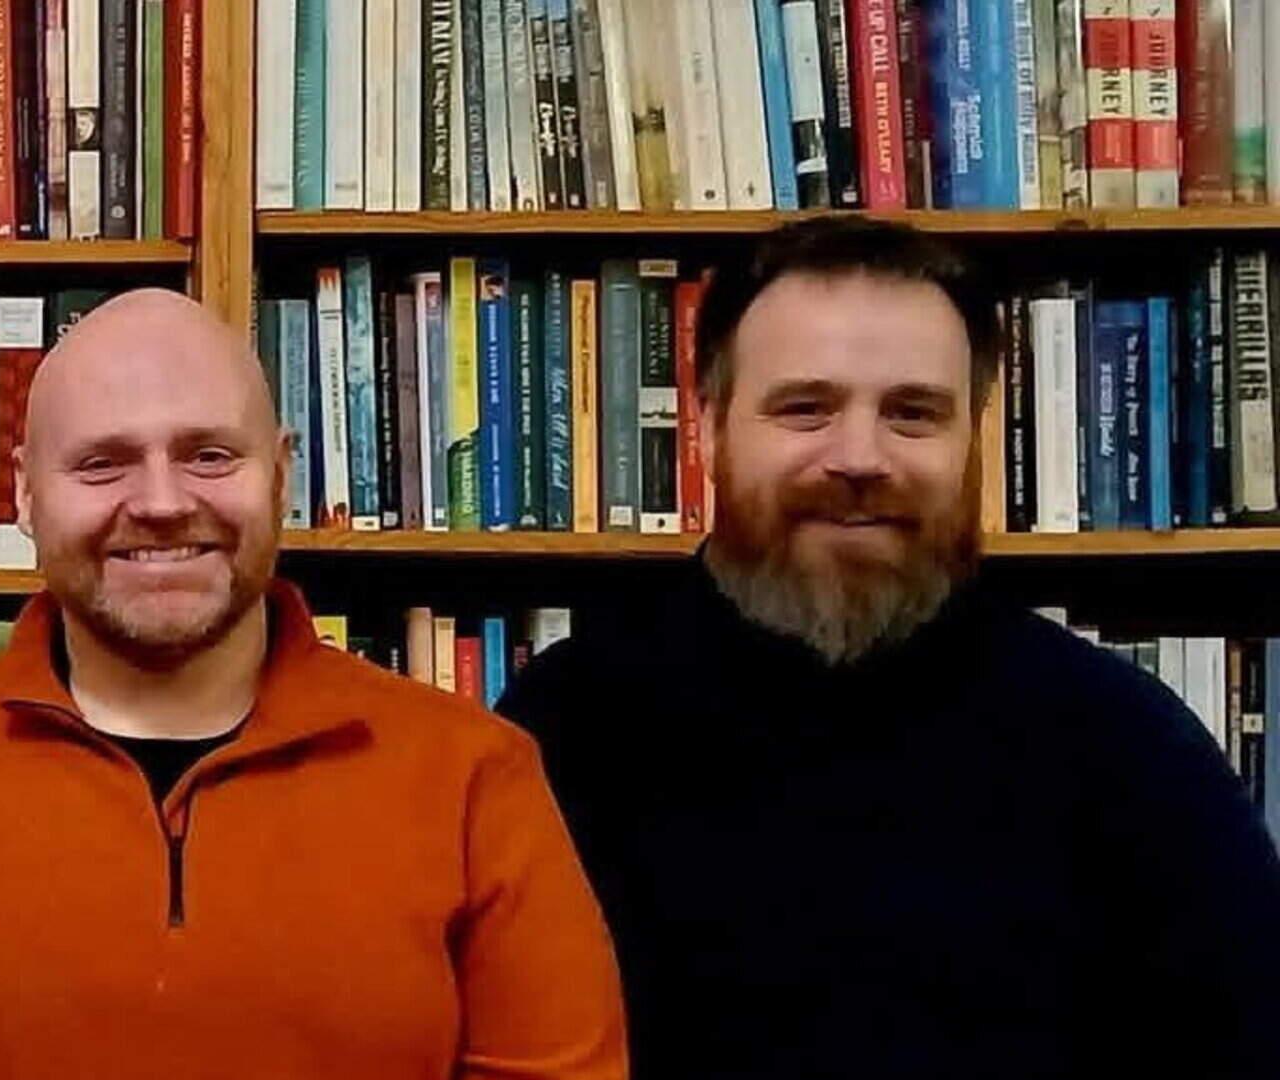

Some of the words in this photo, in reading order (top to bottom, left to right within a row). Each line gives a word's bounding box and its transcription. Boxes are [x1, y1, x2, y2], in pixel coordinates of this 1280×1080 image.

[870, 35, 890, 72] CALL
[1100, 31, 1124, 115] JOURNEY
[1148, 32, 1169, 117] JOURNEY
[1234, 253, 1269, 402] GUERRILLAS
